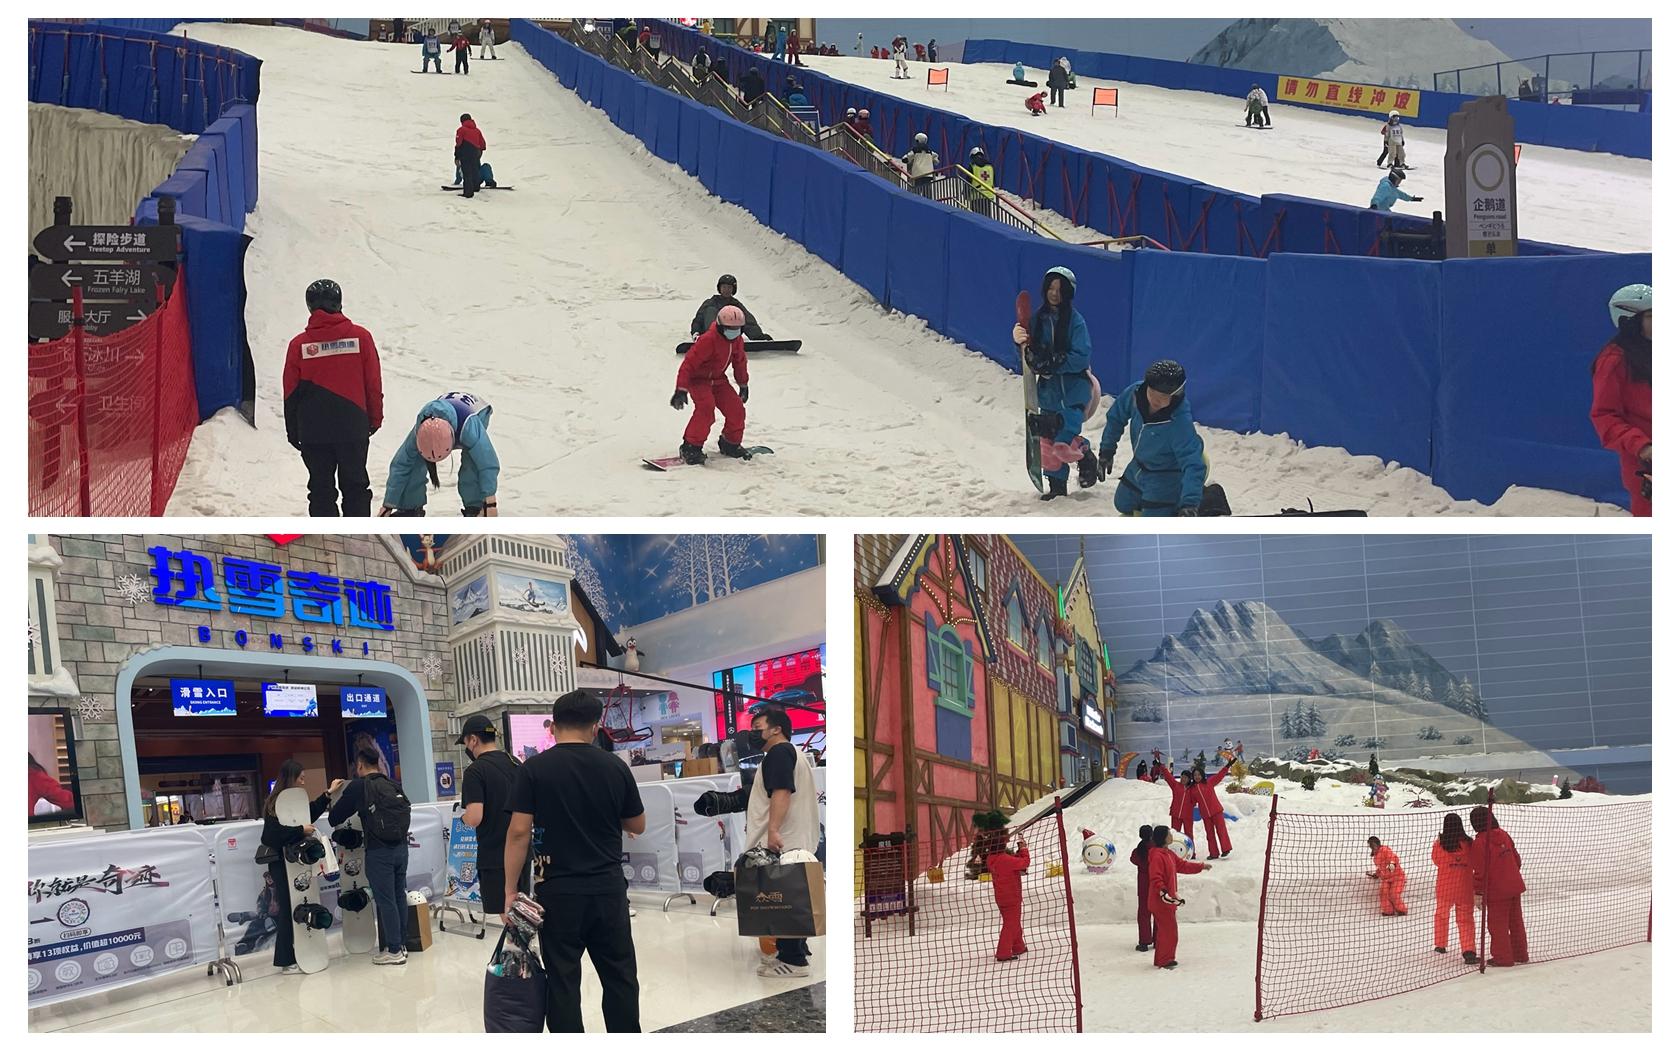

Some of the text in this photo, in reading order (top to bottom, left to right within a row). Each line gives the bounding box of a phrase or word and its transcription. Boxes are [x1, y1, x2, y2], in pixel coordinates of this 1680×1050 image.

[1284, 78, 1411, 110] 请勿直线冲坡
[1473, 198, 1506, 212] 企鹅道
[92, 232, 147, 247] 探险步道
[1486, 242, 1496, 255] 单
[92, 269, 141, 286] 五羊湖
[87, 286, 110, 294] Frozen
[111, 286, 128, 294] Fairy
[57, 310, 112, 324] 服大厅
[57, 346, 120, 363] 飞冰川
[148, 545, 395, 632] 热雪奇迹
[197, 626, 370, 656] BONSKI
[180, 687, 228, 698] 滑雪入口
[346, 693, 380, 703] 出口通道
